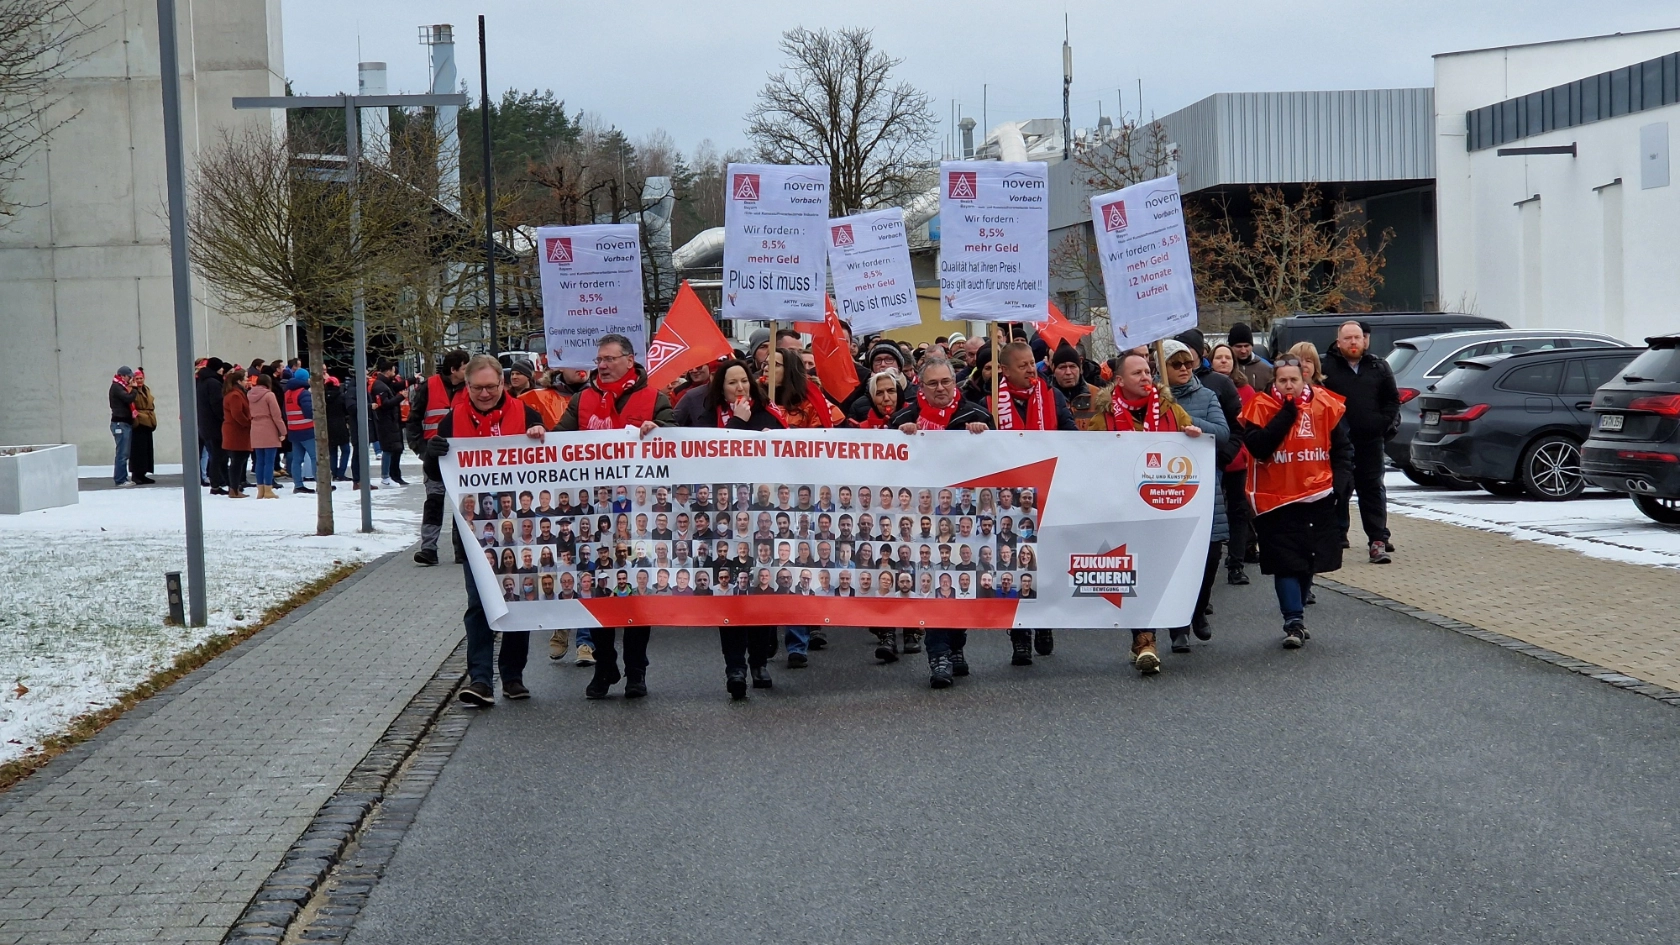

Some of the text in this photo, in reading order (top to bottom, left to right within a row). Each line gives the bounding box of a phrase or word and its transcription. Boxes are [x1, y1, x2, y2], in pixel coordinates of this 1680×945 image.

[784, 182, 824, 191] novem
[1003, 180, 1044, 188] novem
[1146, 192, 1179, 208] novem
[1154, 208, 1179, 220] Vorbach
[743, 225, 760, 234] Wir
[764, 225, 799, 235] fordern
[872, 221, 902, 232] novem
[979, 228, 1004, 238] 8,5%
[596, 241, 636, 250] novem
[762, 240, 786, 250] 8,5%
[964, 243, 1019, 252] mehr Geld
[1108, 251, 1123, 262] Wir
[1126, 243, 1156, 257] fordern
[1162, 234, 1180, 247] 8,5%
[748, 255, 800, 263] mehr Geld
[847, 262, 860, 270] Wir
[862, 258, 890, 268] fordern
[1126, 252, 1169, 272] mehr Geld
[942, 261, 967, 272] Qualität
[968, 262, 980, 272] hat
[981, 262, 997, 272] ihren
[1000, 262, 1016, 273] Preis
[729, 270, 755, 289] Plus
[760, 271, 773, 290] ist
[777, 276, 810, 291] muss
[864, 270, 882, 279] 8,5%
[1129, 268, 1172, 287] 12 Monate
[560, 281, 576, 290] Wir
[579, 280, 614, 288] fordern
[855, 279, 895, 292] mehr Geld
[942, 278, 954, 289] Das
[957, 279, 966, 292] gilt
[968, 279, 984, 290] auch
[985, 279, 995, 289] für
[996, 282, 1015, 290] unsre
[1016, 280, 1036, 290] Arbeit
[1137, 283, 1168, 300] Laufzeit
[580, 294, 603, 303] 8,5%
[843, 298, 865, 314] Plus
[867, 296, 879, 310] ist
[881, 292, 907, 308] muss
[568, 306, 618, 316] mehr Geld
[549, 327, 575, 335] Gewinne
[577, 325, 599, 336] steigen
[606, 325, 625, 334] Löhne
[627, 324, 642, 332] nicht
[457, 437, 908, 468] WIR ZEIGEN GESICHT FÜR UNSEREN TARIFVERTRAG
[1273, 449, 1294, 463] Wir
[459, 465, 669, 487] NOVEM VORBACH HALT ZAM
[1073, 556, 1130, 569] ZUKUNFT
[1075, 571, 1135, 584] SICHERN.
